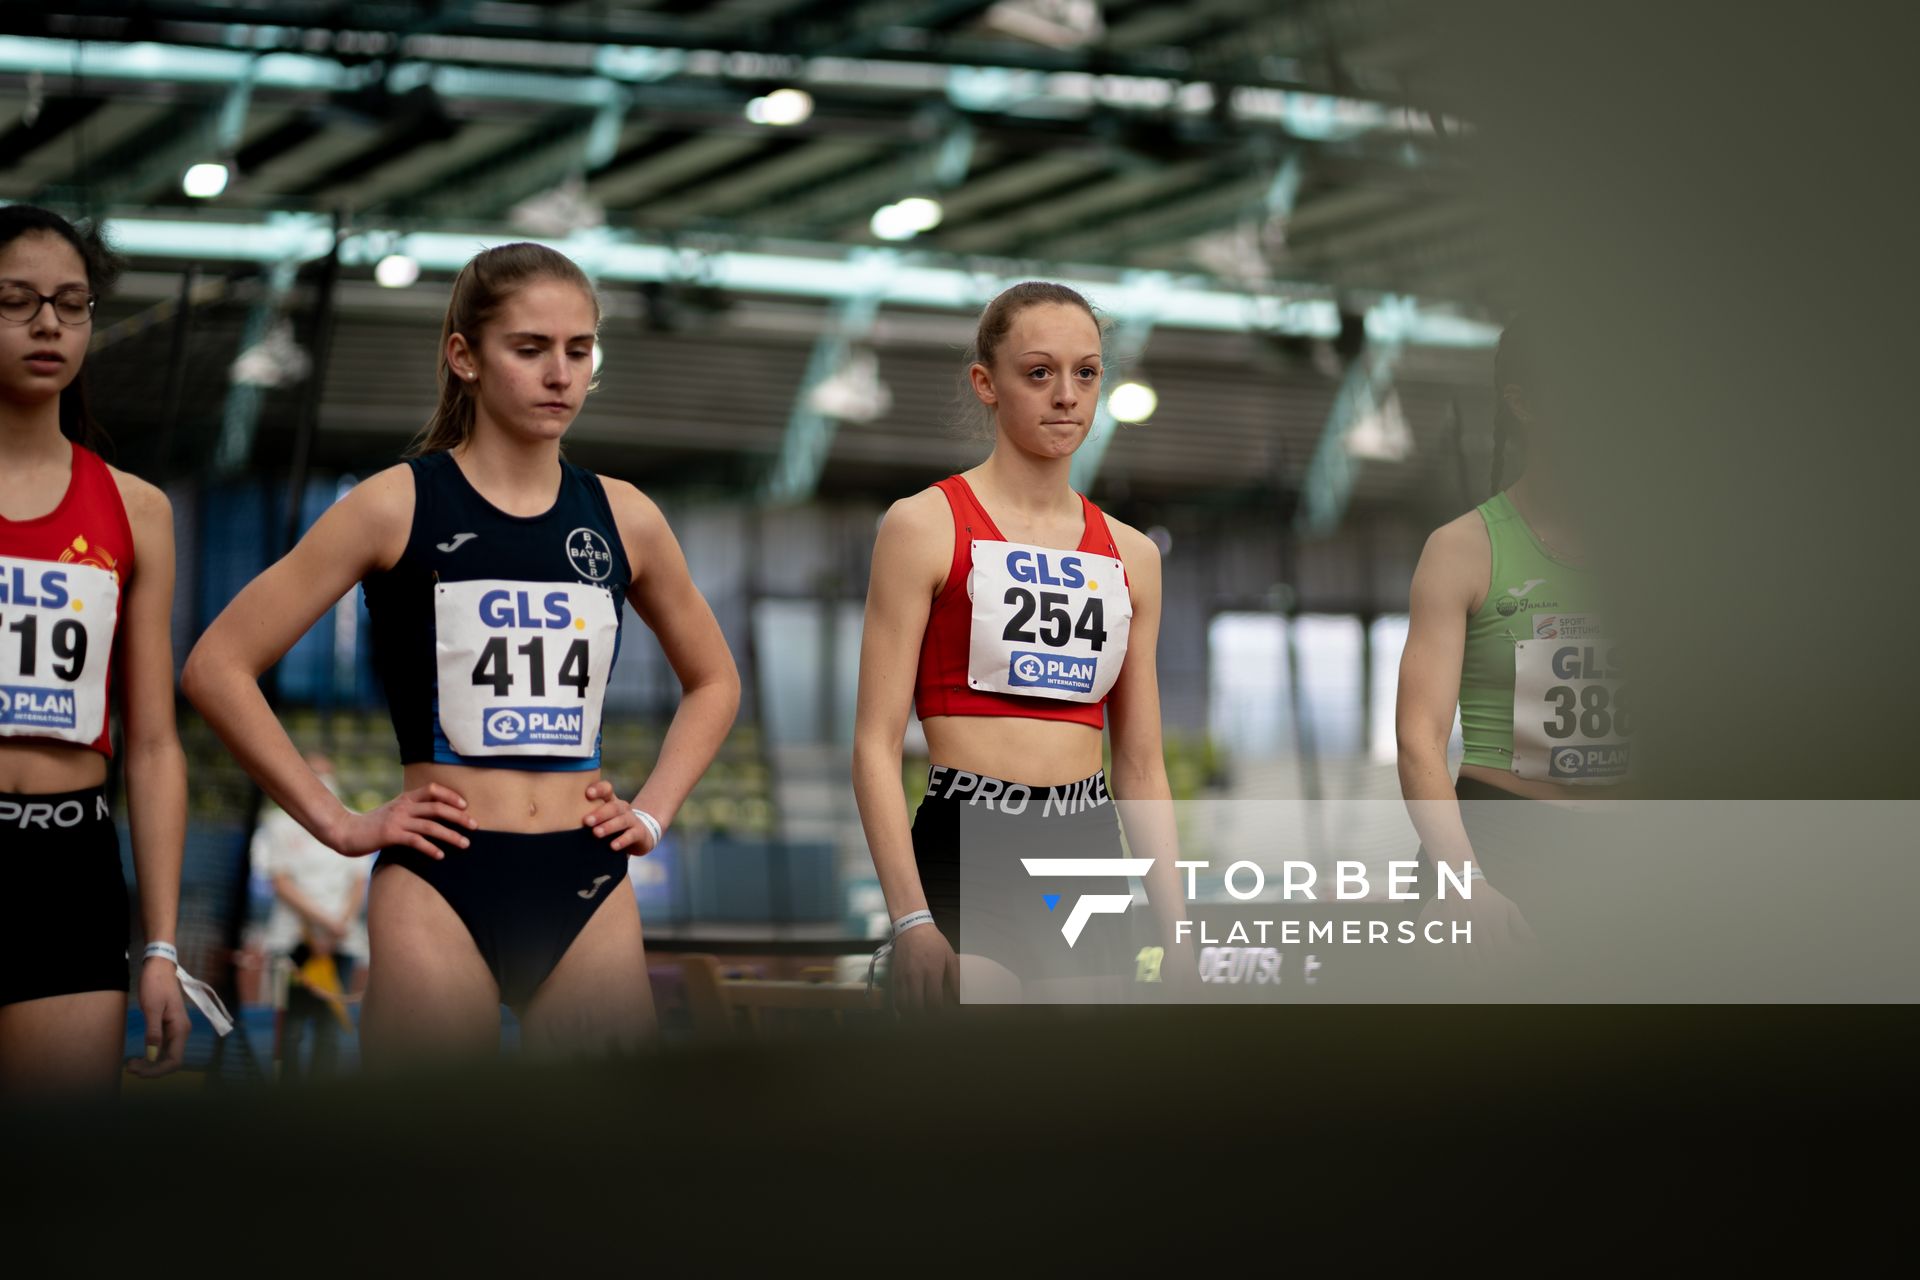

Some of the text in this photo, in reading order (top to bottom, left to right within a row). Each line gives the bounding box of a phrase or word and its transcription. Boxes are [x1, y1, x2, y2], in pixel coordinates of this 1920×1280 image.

[571, 548, 609, 561] BAYER
[583, 532, 598, 576] BAYER
[1002, 587, 1108, 652] 254
[0, 613, 88, 682] 19
[471, 636, 591, 699] 414
[1047, 660, 1094, 681] PLAN
[1047, 678, 1091, 689] INTERNATIONAL
[14, 691, 73, 714] PLAN
[14, 712, 73, 724] INTERNATIONAL
[529, 713, 581, 732] PLAN
[529, 732, 580, 741] INTERNATIONAL
[944, 770, 1031, 815] PRO
[1042, 771, 1108, 817] NIKE
